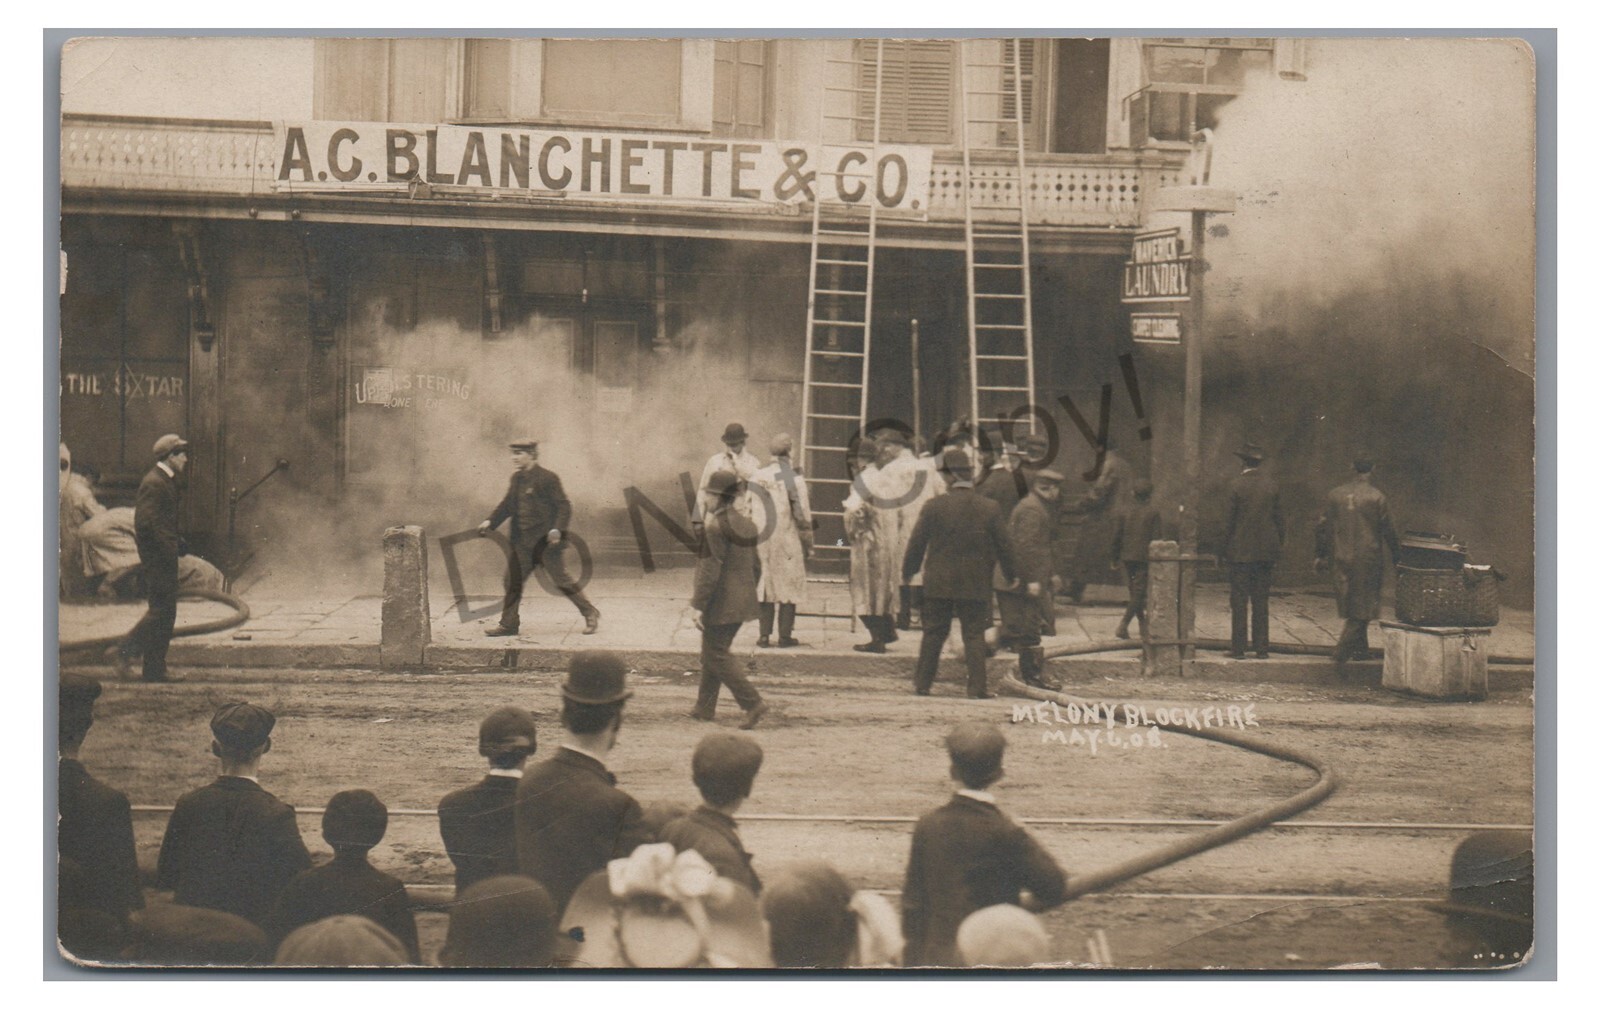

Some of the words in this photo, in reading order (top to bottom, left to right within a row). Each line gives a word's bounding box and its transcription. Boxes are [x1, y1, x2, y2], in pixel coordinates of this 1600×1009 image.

[386, 129, 762, 199] BLANCHETTE
[773, 148, 817, 201] &
[835, 151, 920, 208] CO.
[1125, 262, 1188, 296] LAUNDRY
[66, 373, 102, 395] THE
